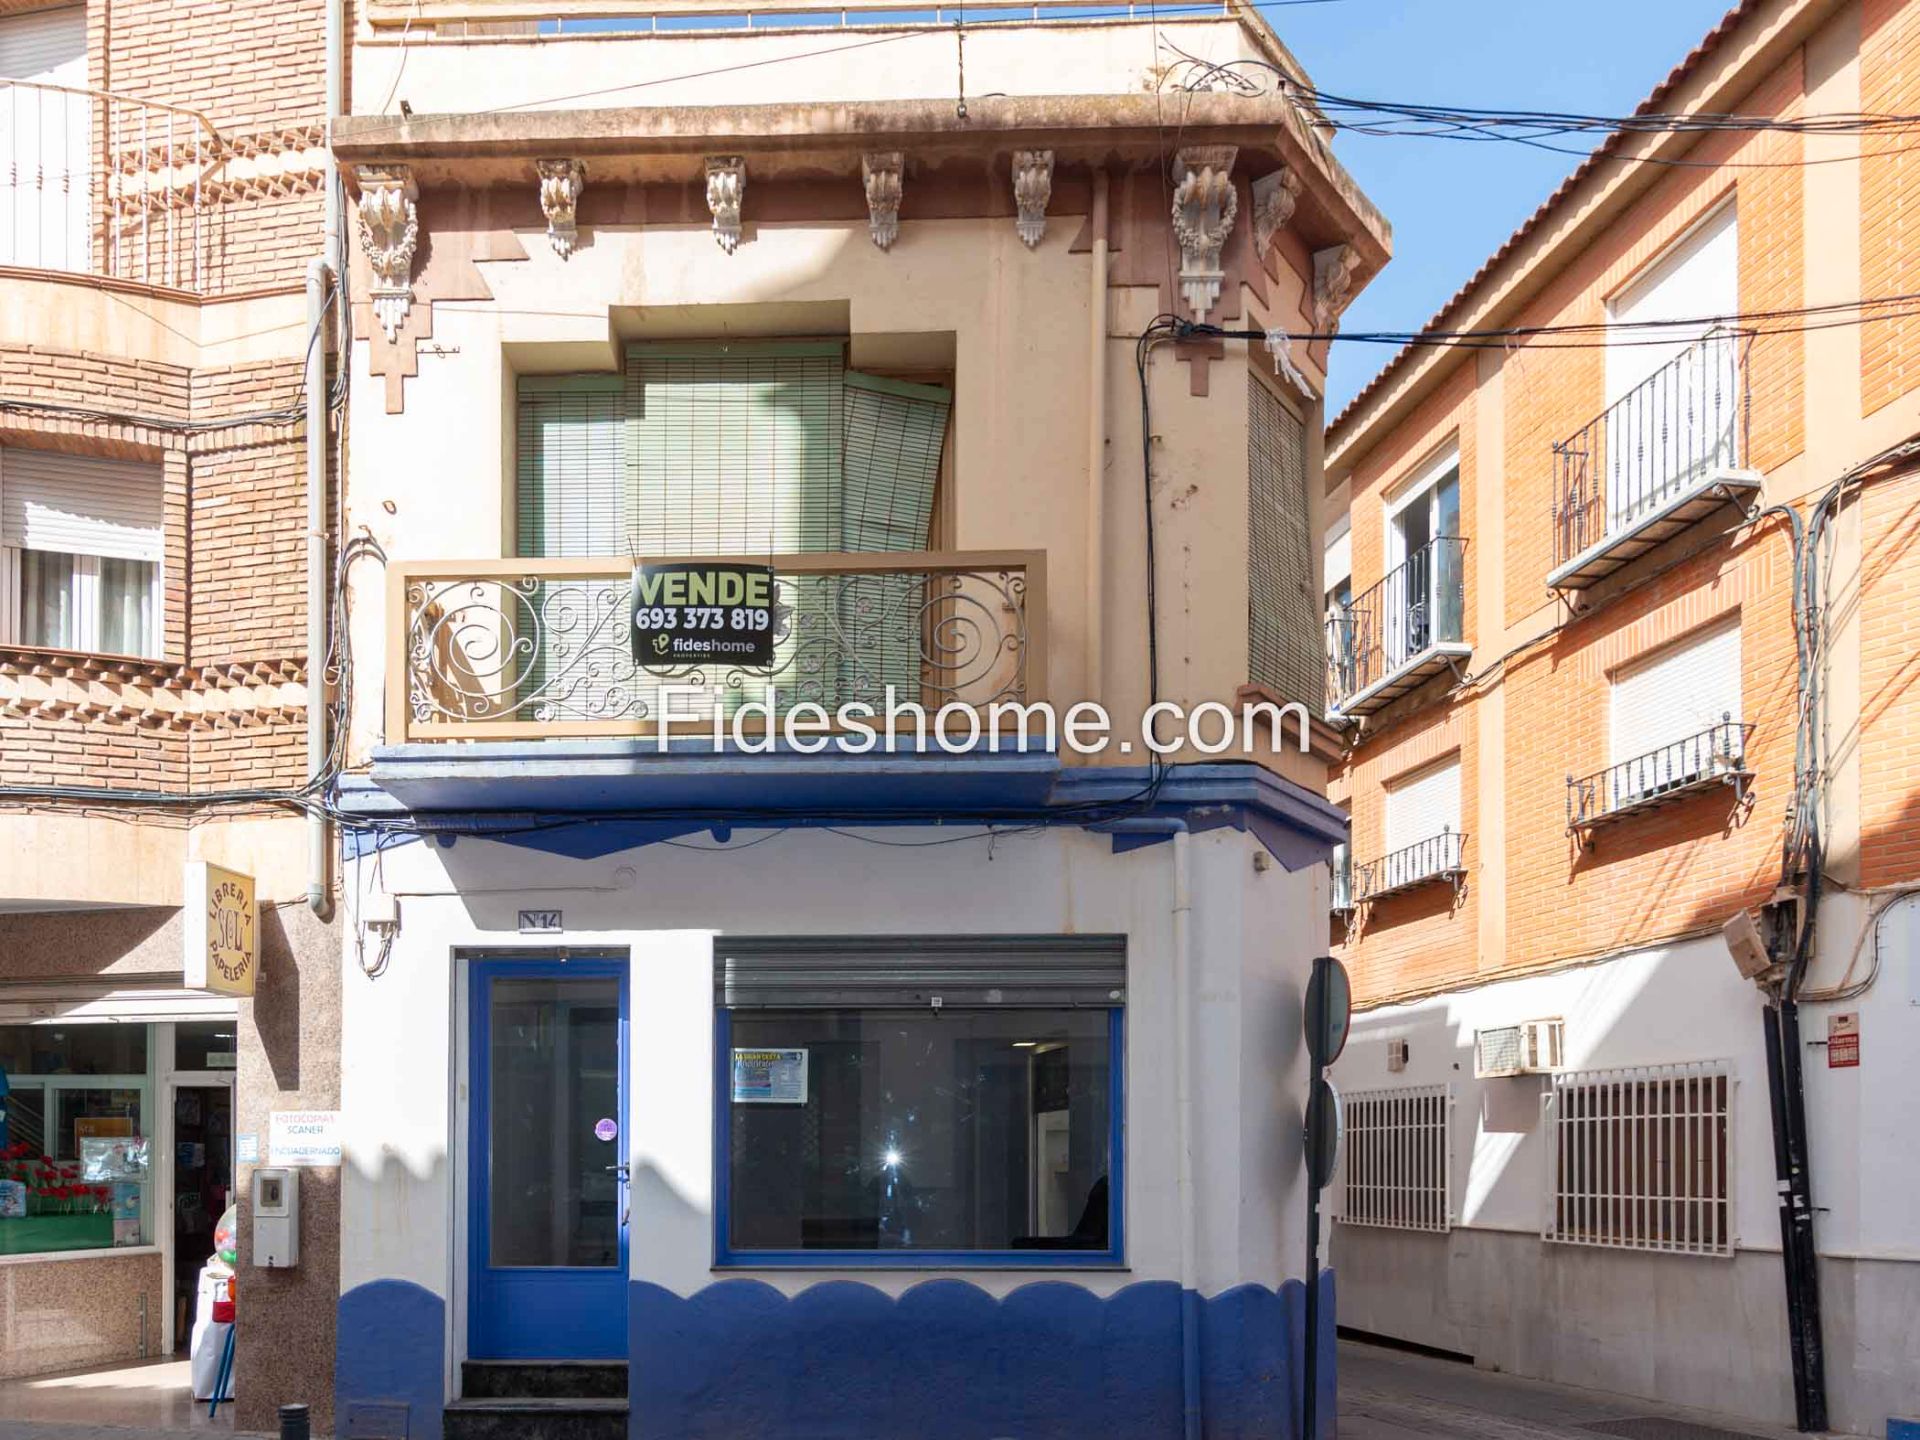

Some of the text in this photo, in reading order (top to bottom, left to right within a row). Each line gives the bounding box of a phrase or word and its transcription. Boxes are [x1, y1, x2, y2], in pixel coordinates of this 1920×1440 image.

[638, 571, 770, 607] VENDE
[636, 607, 769, 631] 693 373 819
[673, 637, 756, 653] fideshome
[287, 1125, 324, 1135] SCANER
